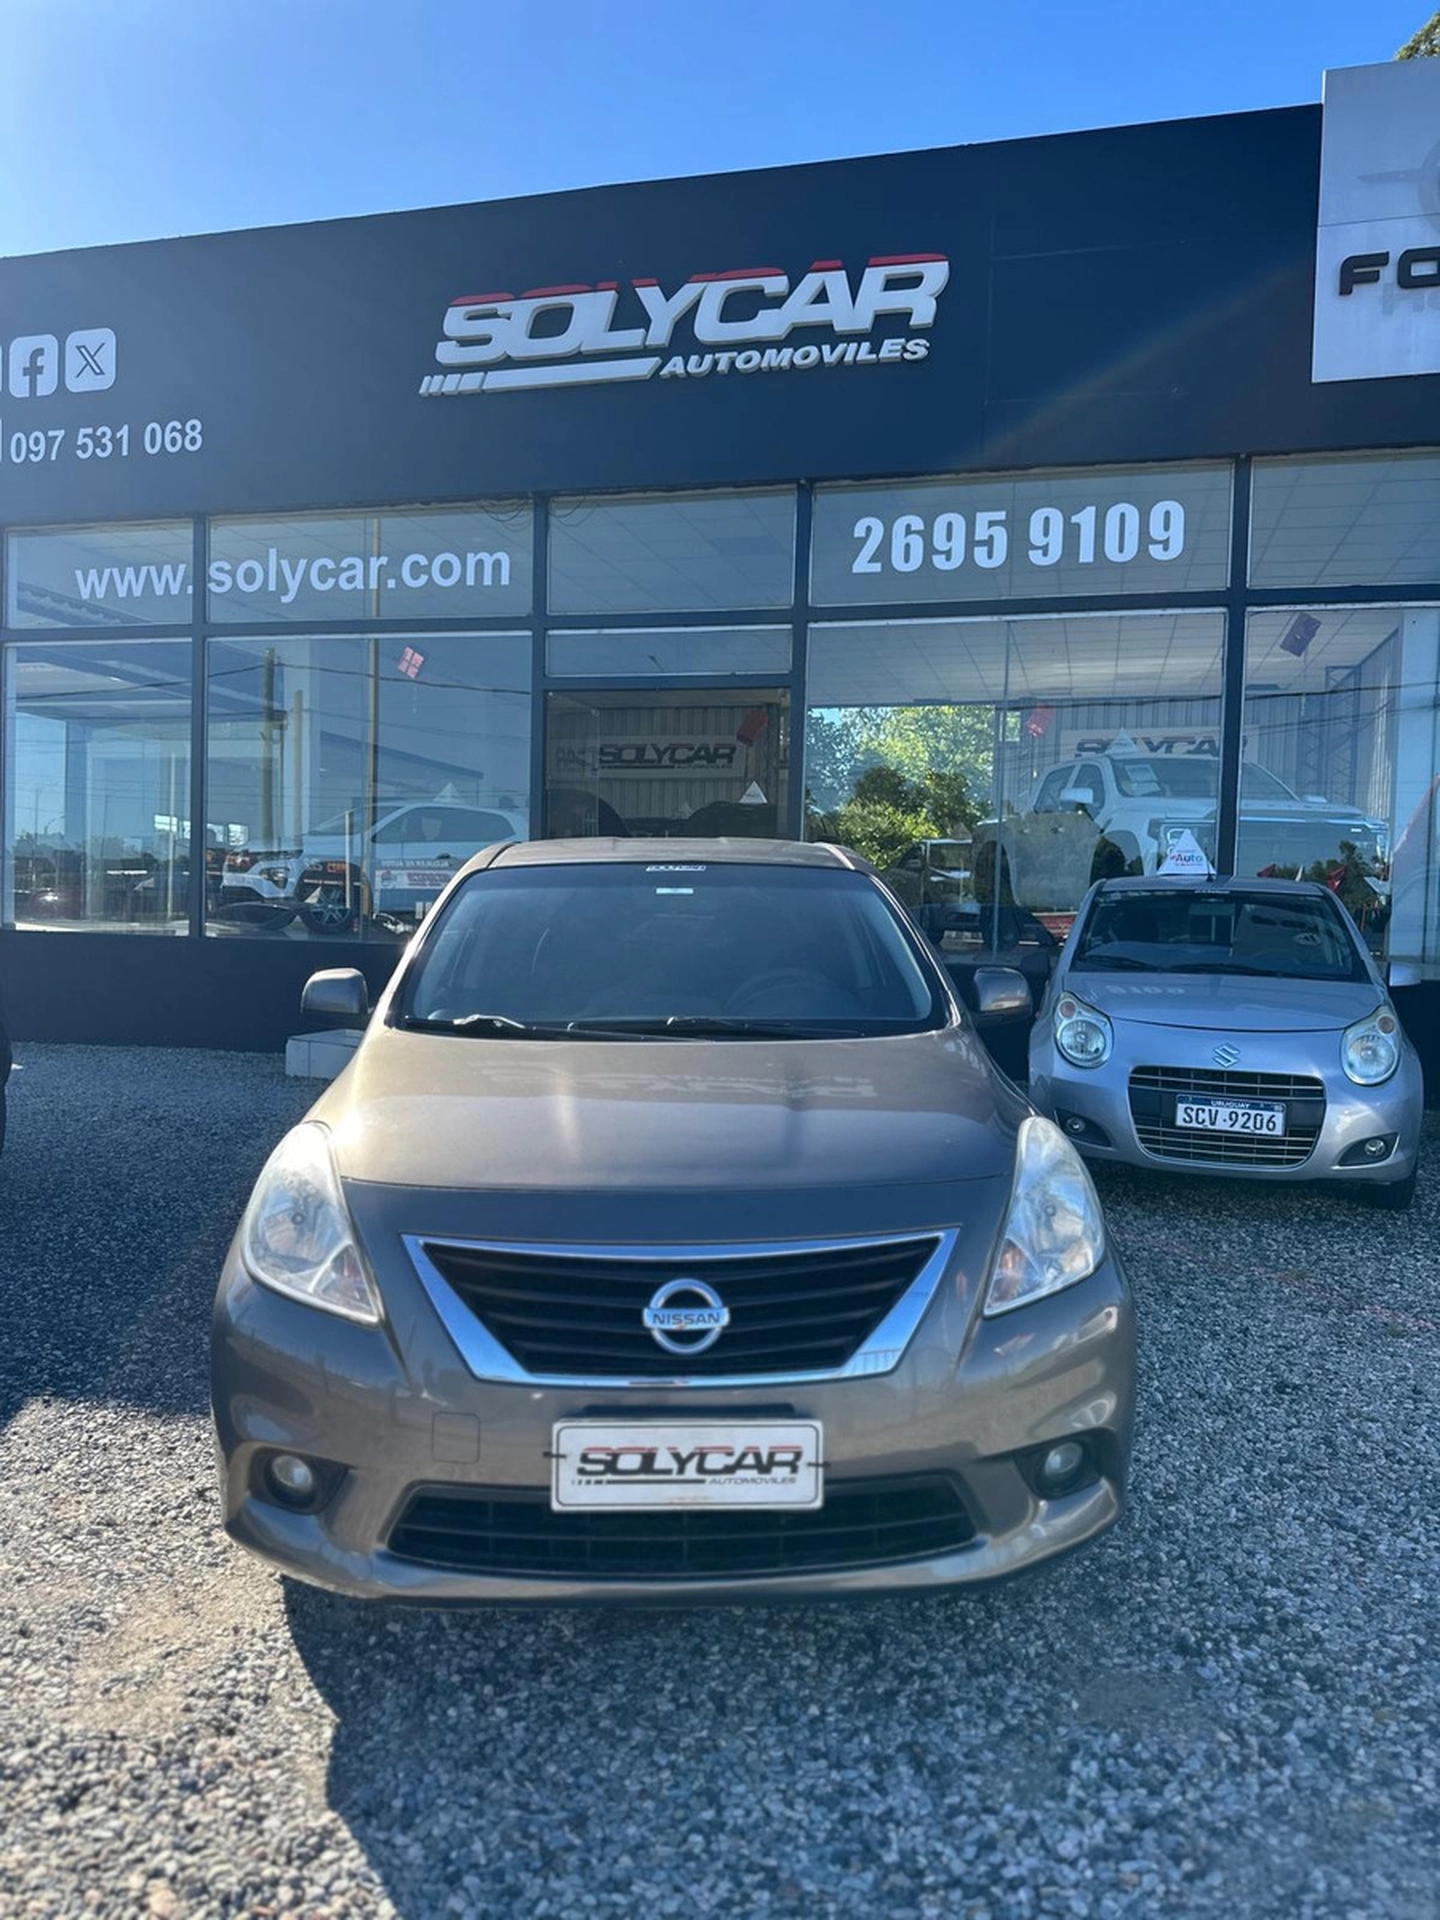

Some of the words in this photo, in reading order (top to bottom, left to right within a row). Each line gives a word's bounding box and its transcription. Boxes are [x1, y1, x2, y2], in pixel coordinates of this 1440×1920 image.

[434, 253, 950, 366] SOLYCAR
[658, 338, 931, 379] AUTOMOVILES
[10, 431, 66, 464] 097
[76, 424, 130, 459] 531
[144, 418, 204, 455] 068
[851, 509, 1008, 574] 2695
[1027, 500, 1186, 567] 9109
[598, 743, 737, 764] SOLYCAR
[1210, 1101, 1251, 1110] URUGUAY
[652, 1312, 721, 1326] NISSAN
[576, 1446, 804, 1478] SOLYCAR
[708, 1477, 798, 1486] AUTOMOVILES
